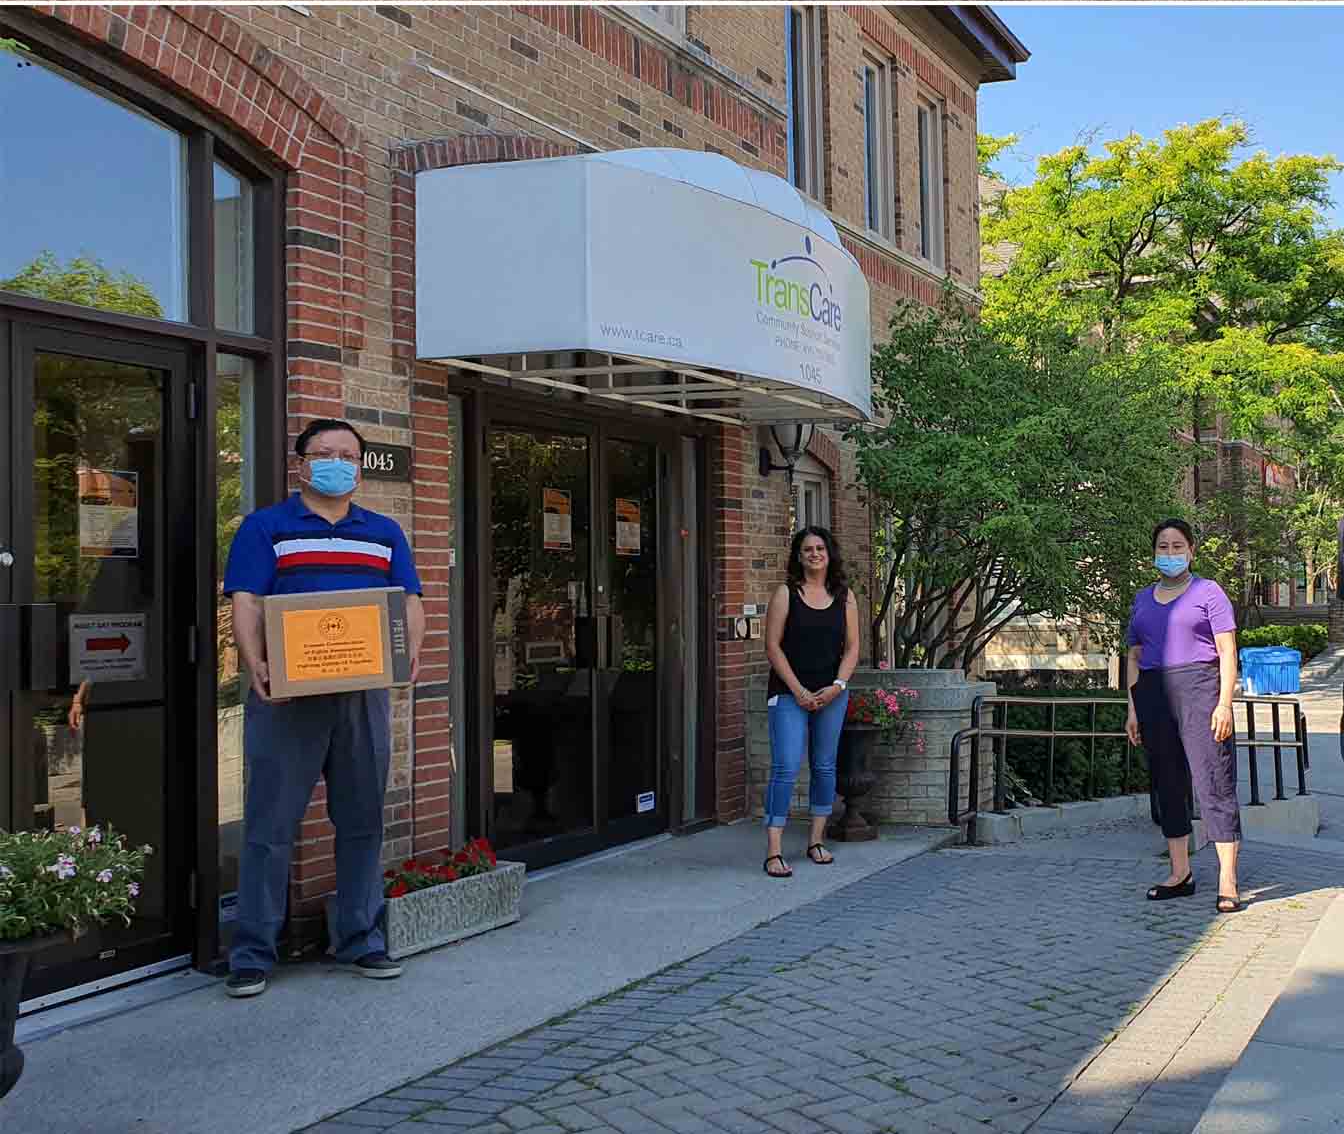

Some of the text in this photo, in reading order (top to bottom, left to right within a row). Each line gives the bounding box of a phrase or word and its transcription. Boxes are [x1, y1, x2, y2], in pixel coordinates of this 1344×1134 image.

[750, 258, 842, 332] TransCare
[799, 362, 823, 386] 1045
[362, 451, 394, 471] 1045
